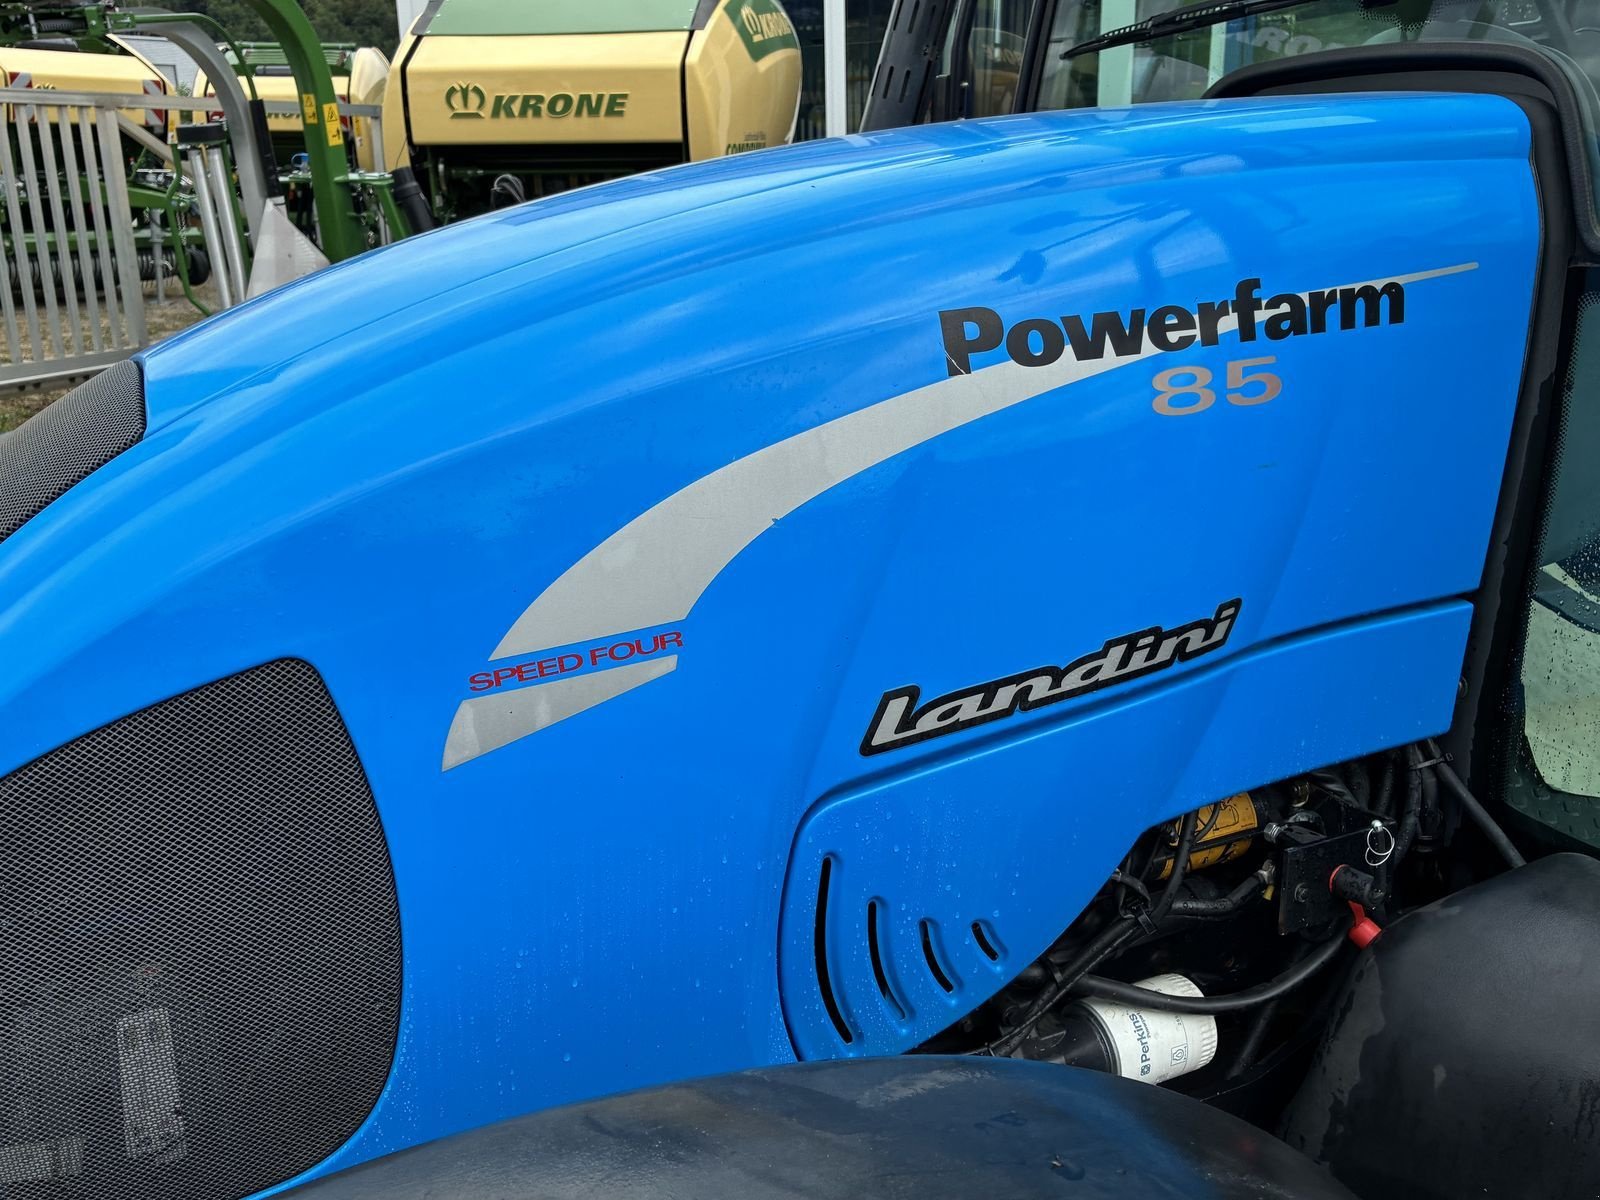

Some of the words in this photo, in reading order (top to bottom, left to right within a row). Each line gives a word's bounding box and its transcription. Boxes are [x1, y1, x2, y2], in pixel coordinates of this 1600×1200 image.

[491, 92, 630, 119] KRONE
[938, 278, 1405, 376] Powerfarm
[1151, 355, 1283, 416] 85
[468, 653, 584, 692] SPEED
[589, 631, 684, 666] FOUR
[864, 602, 1239, 751] Landini
[1129, 1012, 1151, 1064] Perkins
